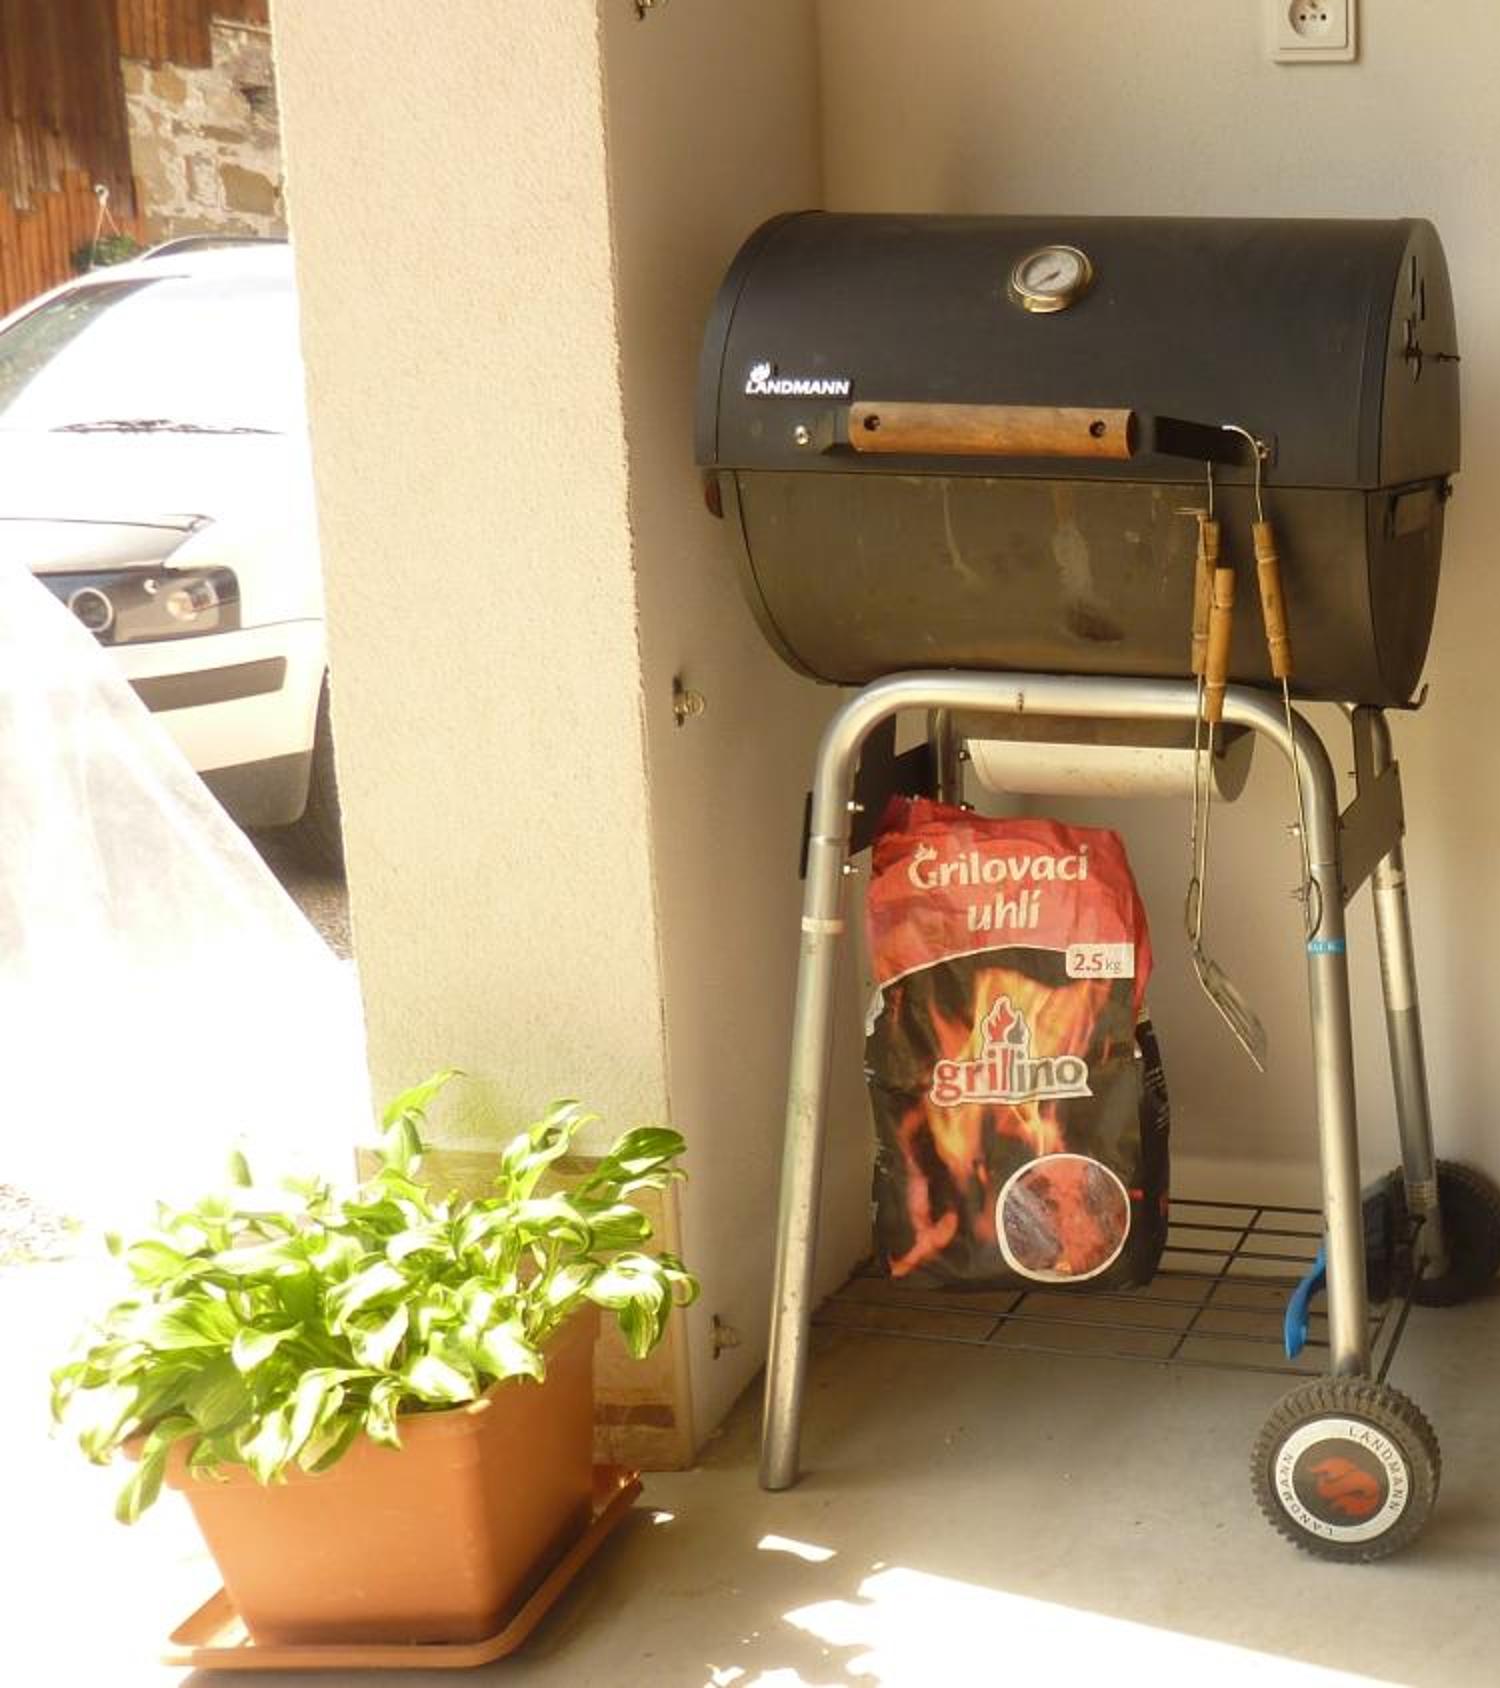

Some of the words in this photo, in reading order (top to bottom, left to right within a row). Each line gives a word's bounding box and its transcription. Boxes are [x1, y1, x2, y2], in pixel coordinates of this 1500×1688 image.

[745, 380, 850, 395] LANDMANN
[968, 889, 1041, 931] uhlí
[1105, 959, 1121, 974] kg
[936, 1048, 1084, 1101] grillino
[1349, 1425, 1407, 1511] LANDMANN
